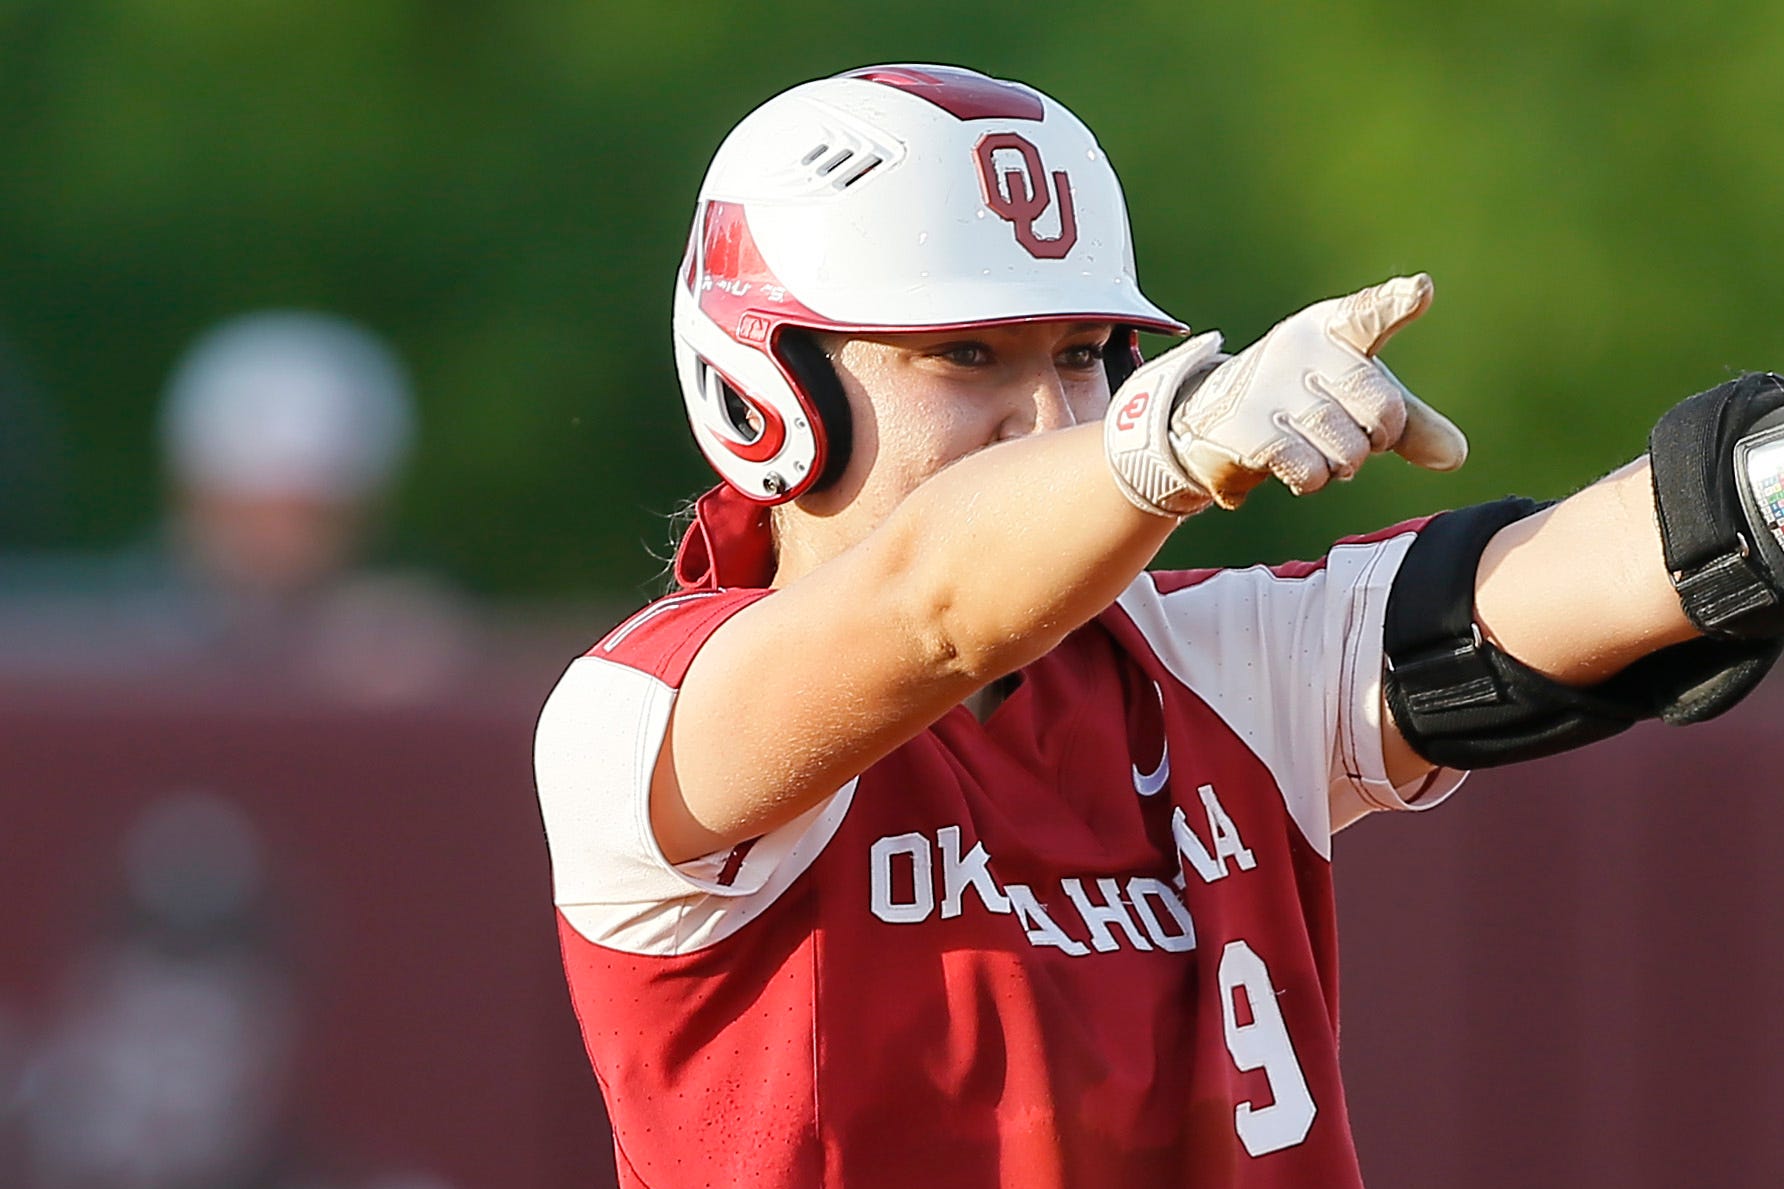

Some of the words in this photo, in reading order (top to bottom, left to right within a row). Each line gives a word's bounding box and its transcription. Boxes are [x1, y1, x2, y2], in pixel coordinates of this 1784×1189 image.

[972, 132, 1078, 260] OU
[870, 783, 1258, 957] OKAHOA
[1217, 938, 1319, 1158] 9
